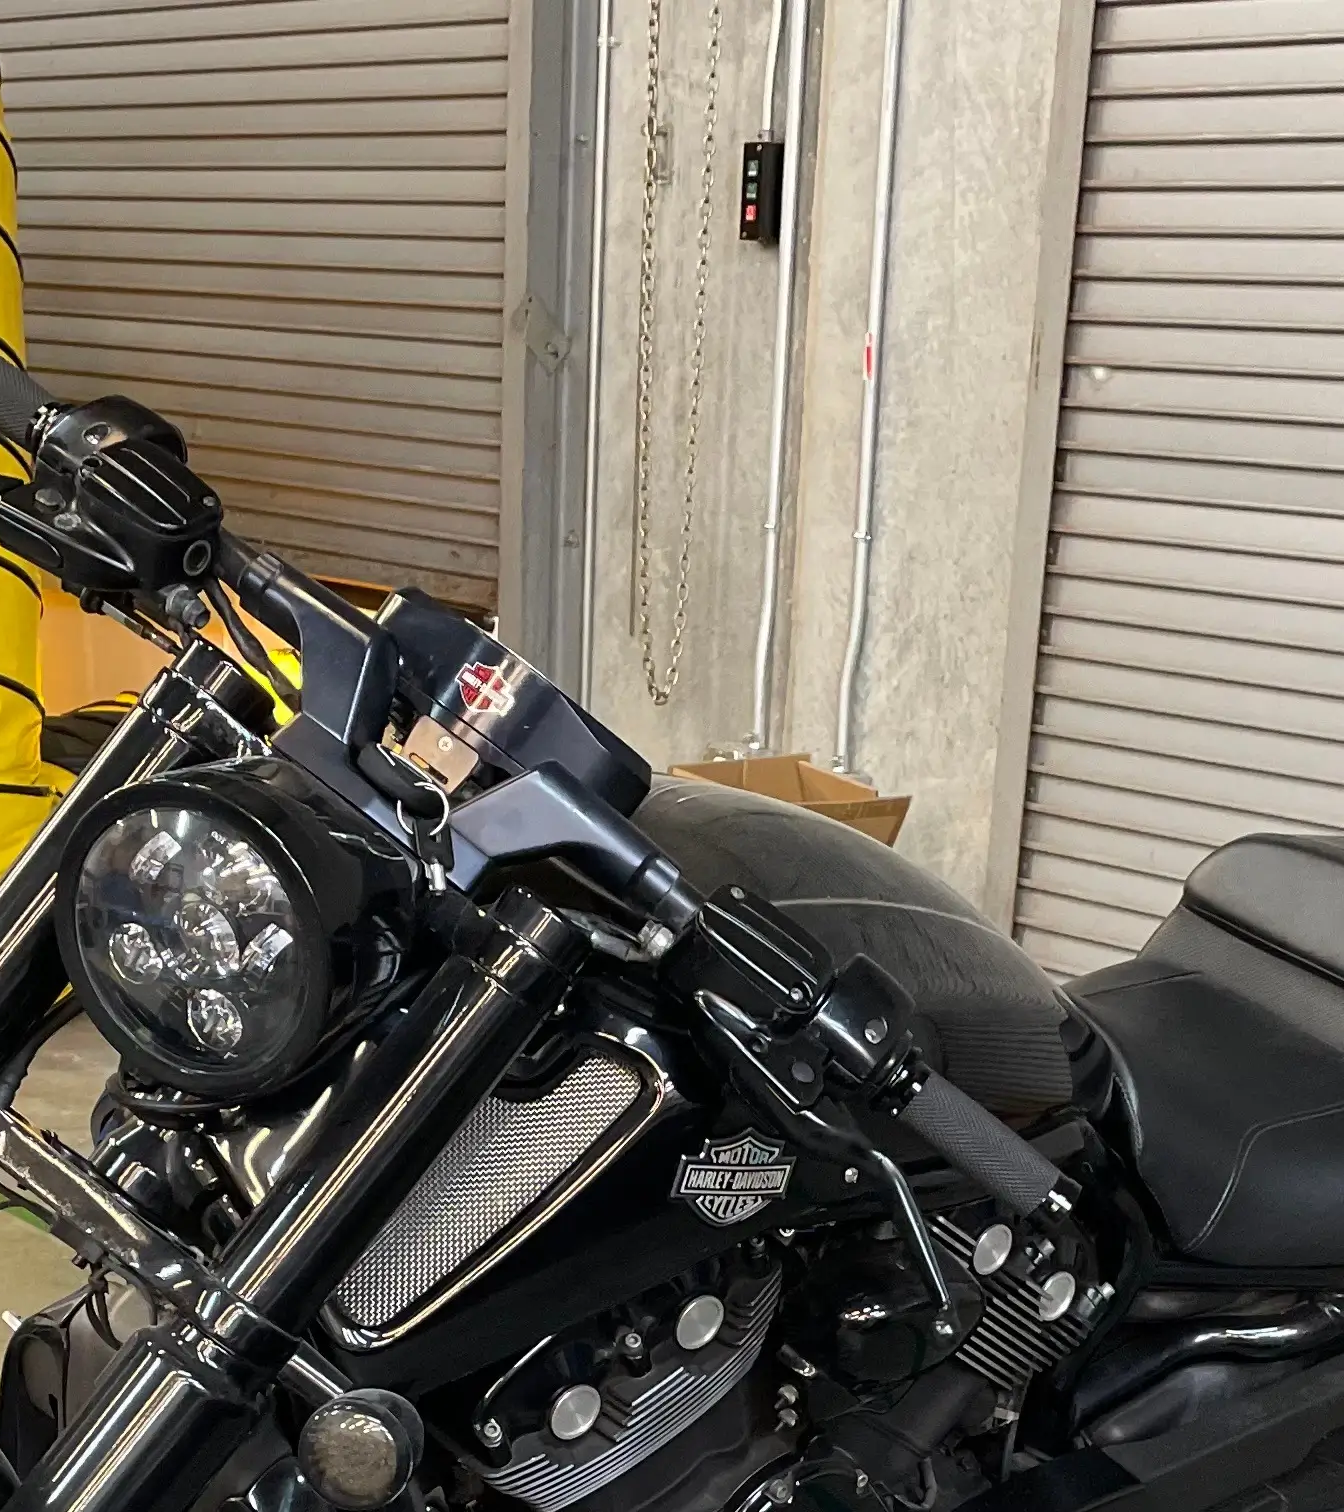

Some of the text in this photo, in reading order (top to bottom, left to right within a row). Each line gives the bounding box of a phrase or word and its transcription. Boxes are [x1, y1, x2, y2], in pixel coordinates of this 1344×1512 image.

[718, 1144, 770, 1164] MOTOR
[687, 1169, 784, 1190] HARLEY-DAVIDSON
[704, 1195, 756, 1218] CYCLES
